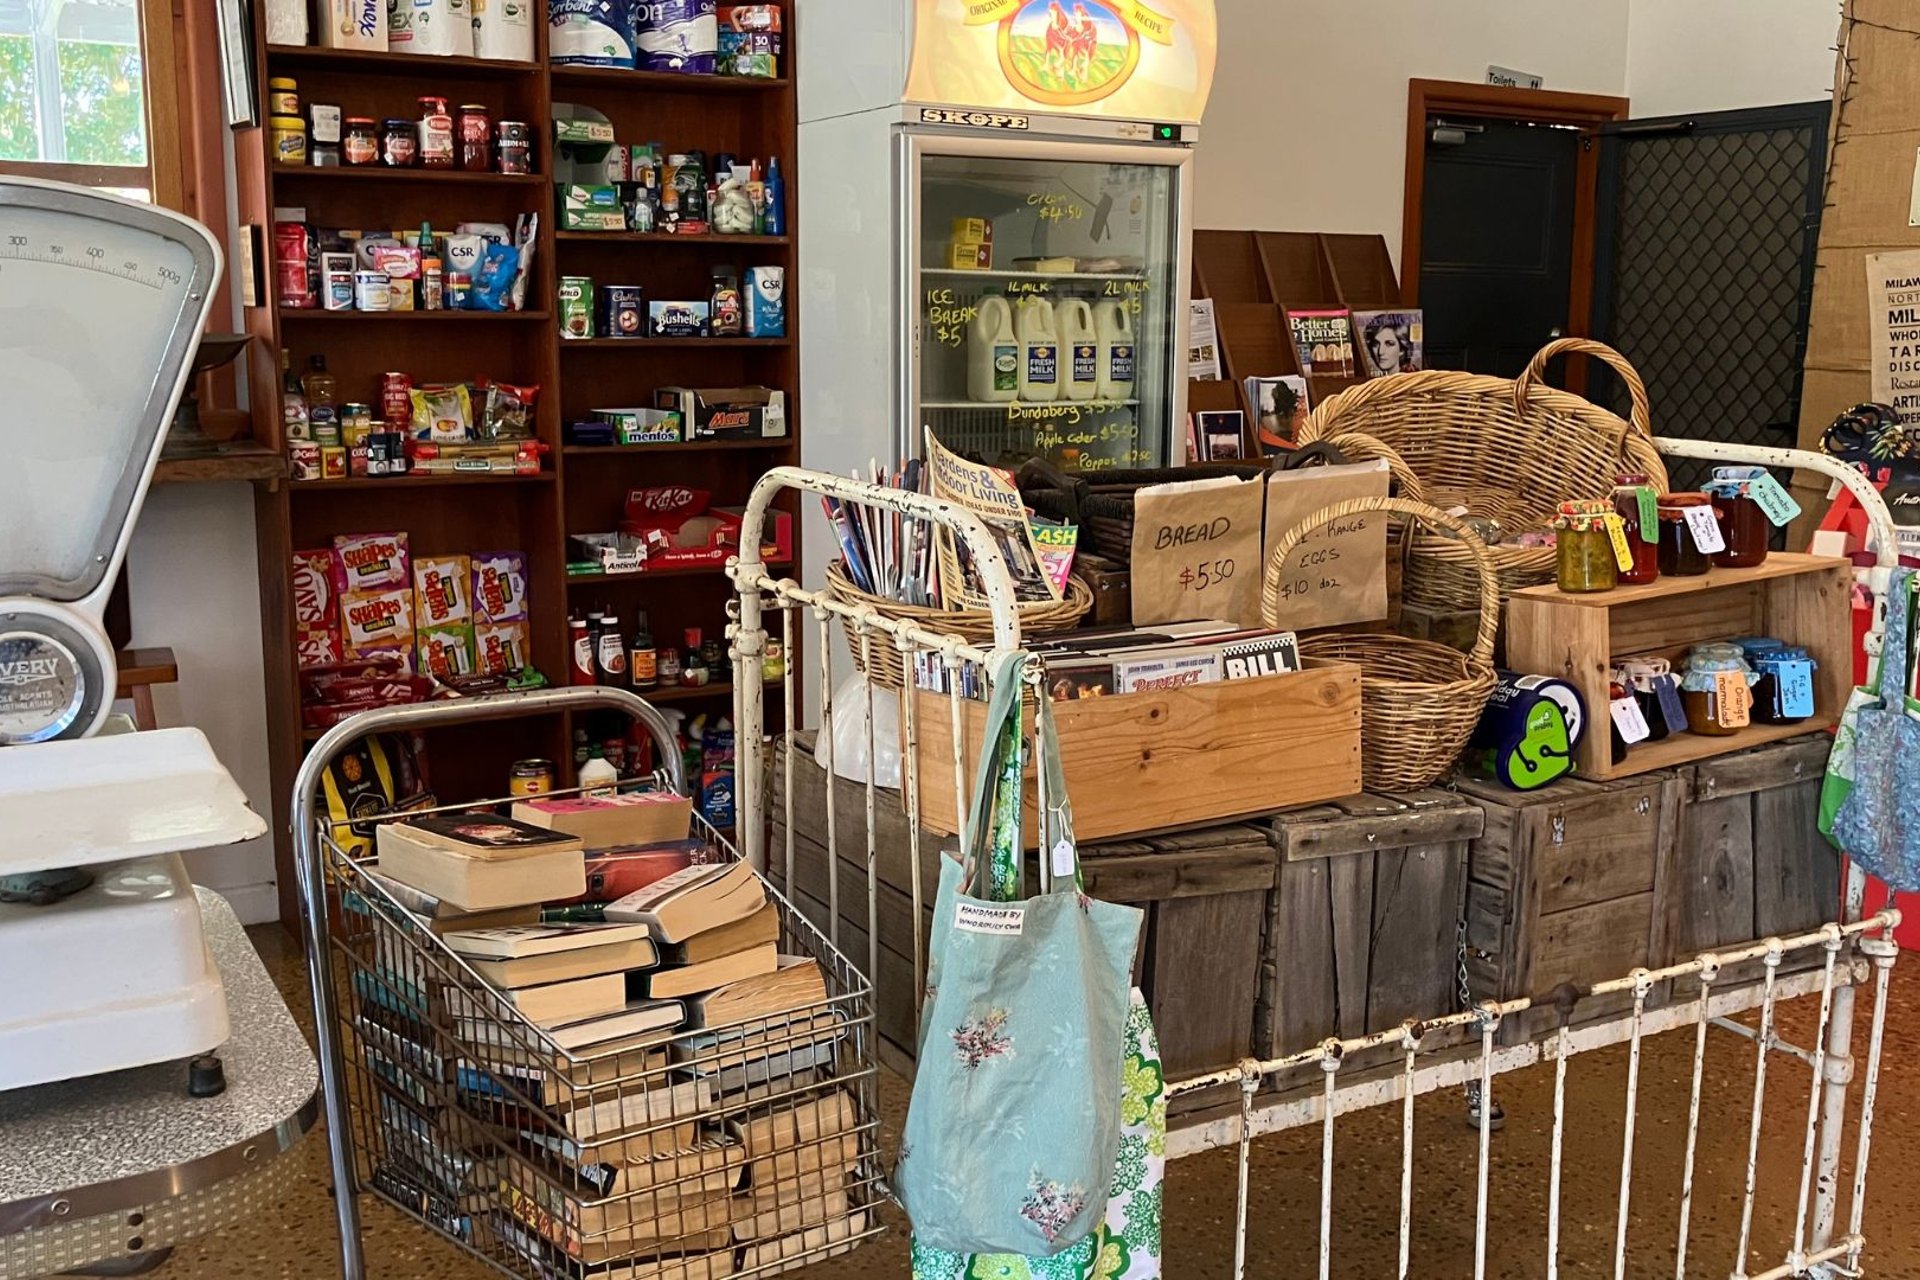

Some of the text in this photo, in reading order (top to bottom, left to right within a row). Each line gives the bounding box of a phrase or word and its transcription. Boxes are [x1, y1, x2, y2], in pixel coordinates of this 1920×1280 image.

[1134, 10, 1163, 34] RECIPE
[922, 109, 1028, 129] SKOPE
[8, 235, 28, 246] 300
[86, 246, 104, 258] 400
[451, 247, 474, 257] CSR
[157, 267, 181, 285] 500g
[762, 280, 781, 290] CSR
[928, 289, 954, 305] ICE
[659, 313, 700, 327] Bushells
[930, 306, 978, 325] BREAK
[1290, 317, 1330, 330] Better
[936, 327, 961, 348] $5
[1302, 328, 1347, 343] Homes
[1030, 358, 1055, 366] FRESH
[1030, 365, 1054, 374] MILK
[1075, 358, 1095, 366] FRESH
[1075, 365, 1095, 373] MILK
[1112, 365, 1132, 373] MILK
[709, 411, 750, 429] Mars
[1008, 400, 1081, 424] Bundaberg
[629, 431, 675, 442] mentos
[1035, 431, 1064, 448] Apple
[936, 452, 997, 490] ardens &
[971, 482, 1019, 509] Living
[984, 504, 1006, 516] UNDER
[1155, 516, 1231, 550] BREAD
[608, 560, 638, 570] Anticol
[1300, 548, 1341, 568] EGGS
[1178, 558, 1235, 591] $5.50
[293, 558, 322, 623] SAVOY
[1281, 579, 1309, 600] $10
[1226, 651, 1293, 680] BILL
[1131, 668, 1203, 693] PERFECT
[1735, 687, 1746, 721] Orange
